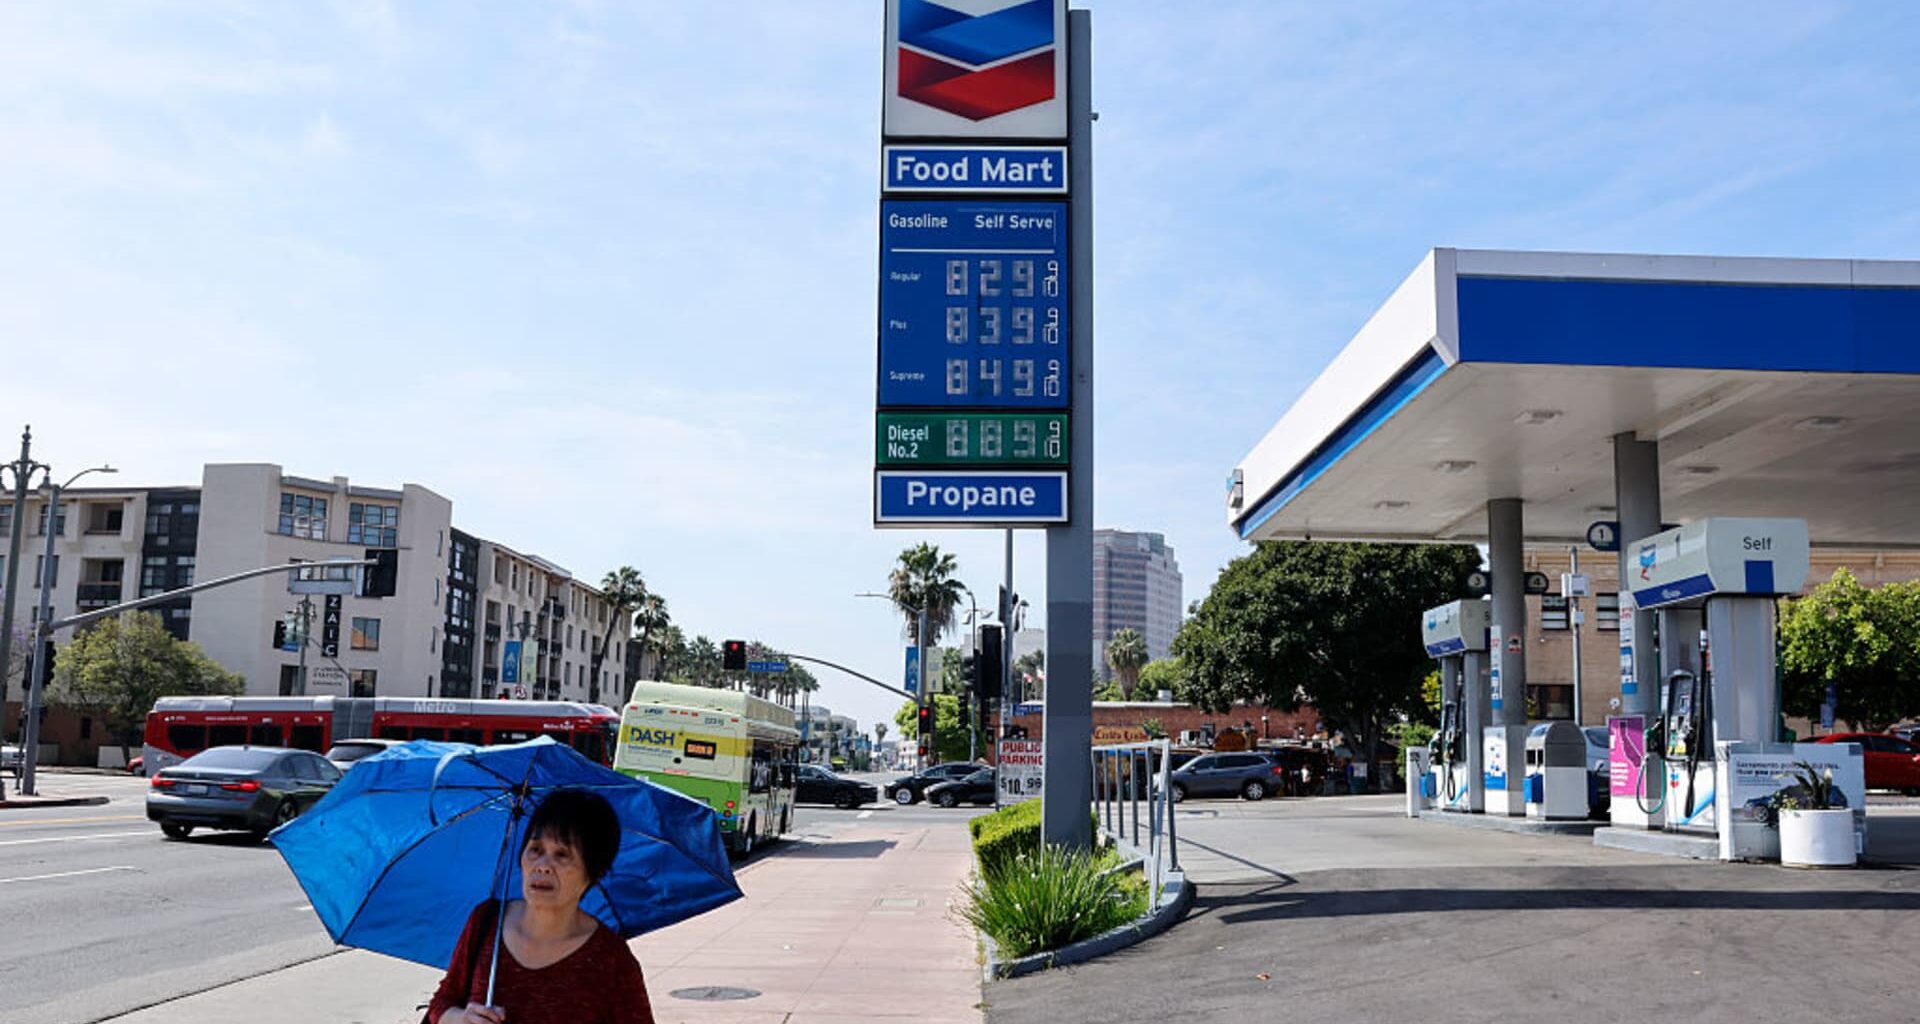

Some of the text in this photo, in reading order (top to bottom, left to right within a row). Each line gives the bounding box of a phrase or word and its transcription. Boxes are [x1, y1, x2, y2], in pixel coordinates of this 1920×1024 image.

[896, 155, 1053, 182] Food Mart
[889, 213, 948, 228] Gasoline
[974, 214, 1053, 229] Self Serve
[946, 260, 1034, 297] 829
[946, 307, 1034, 344] 839
[889, 359, 1034, 397] Supreme 849
[888, 419, 1035, 457] Diesel 889
[888, 443, 918, 458] No.2
[907, 480, 1036, 511] Propane
[1743, 536, 1772, 550] Self
[413, 702, 456, 713] Metro
[630, 727, 675, 746] DASH
[1003, 741, 1042, 753] PUBLIC
